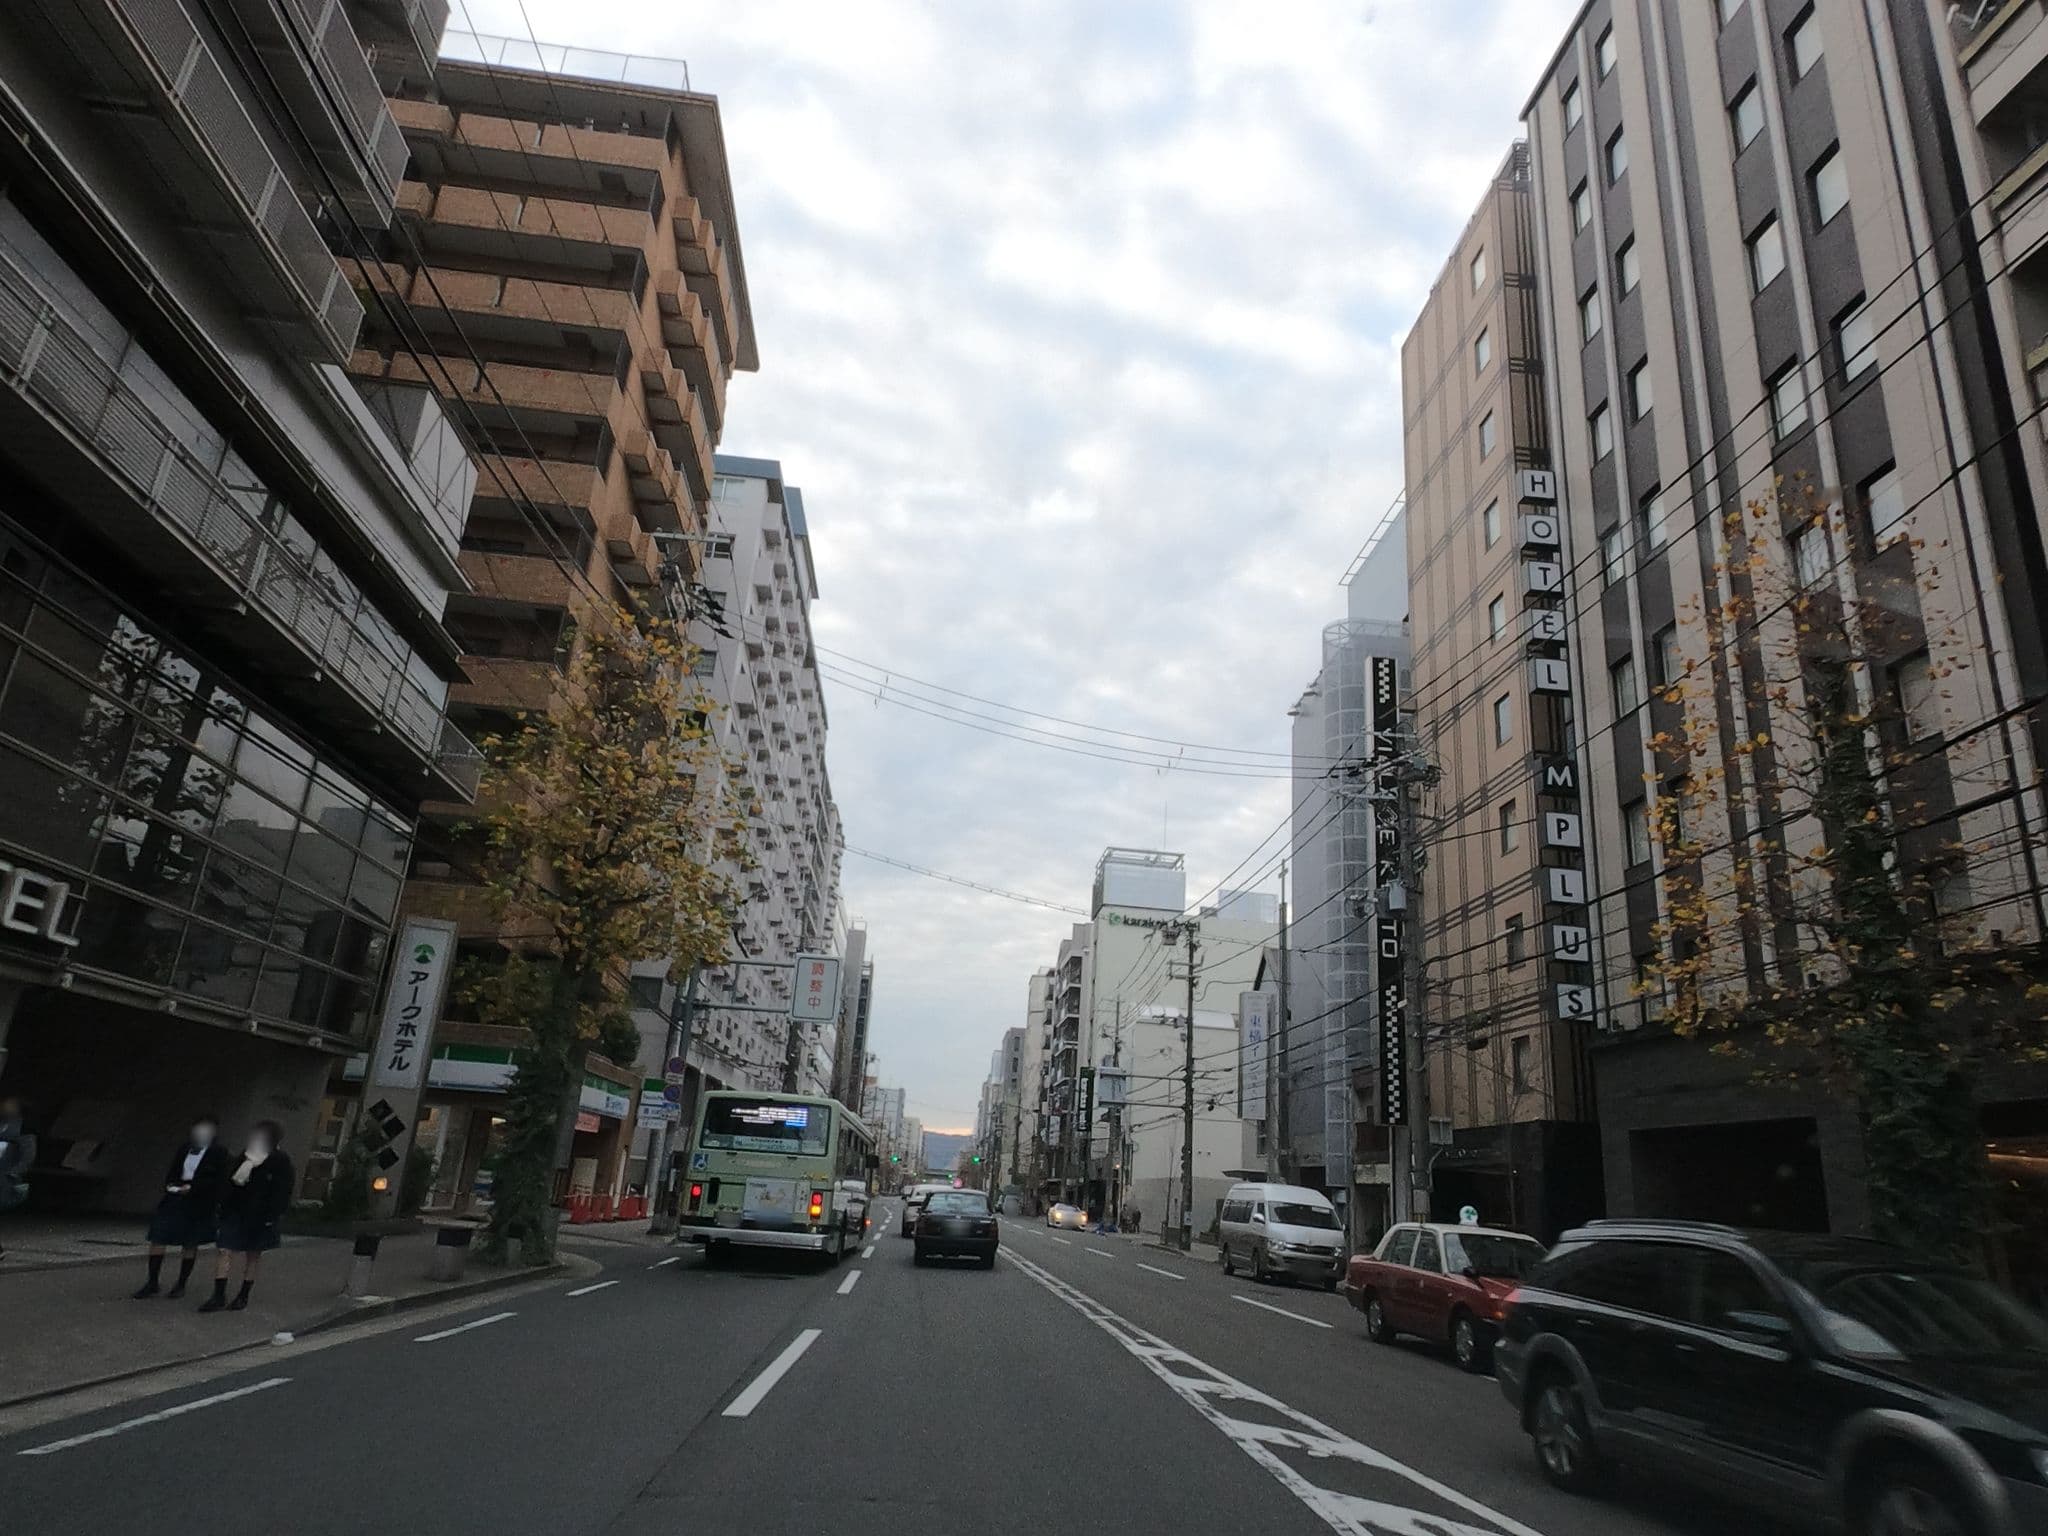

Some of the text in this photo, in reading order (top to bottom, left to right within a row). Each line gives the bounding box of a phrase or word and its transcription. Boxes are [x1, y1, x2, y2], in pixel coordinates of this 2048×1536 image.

[1531, 473, 1559, 687] HOTEL
[0, 860, 80, 947] EL
[1380, 857, 1399, 959] KTO
[387, 970, 433, 1073] アークホテル
[807, 962, 825, 1011] 調整中
